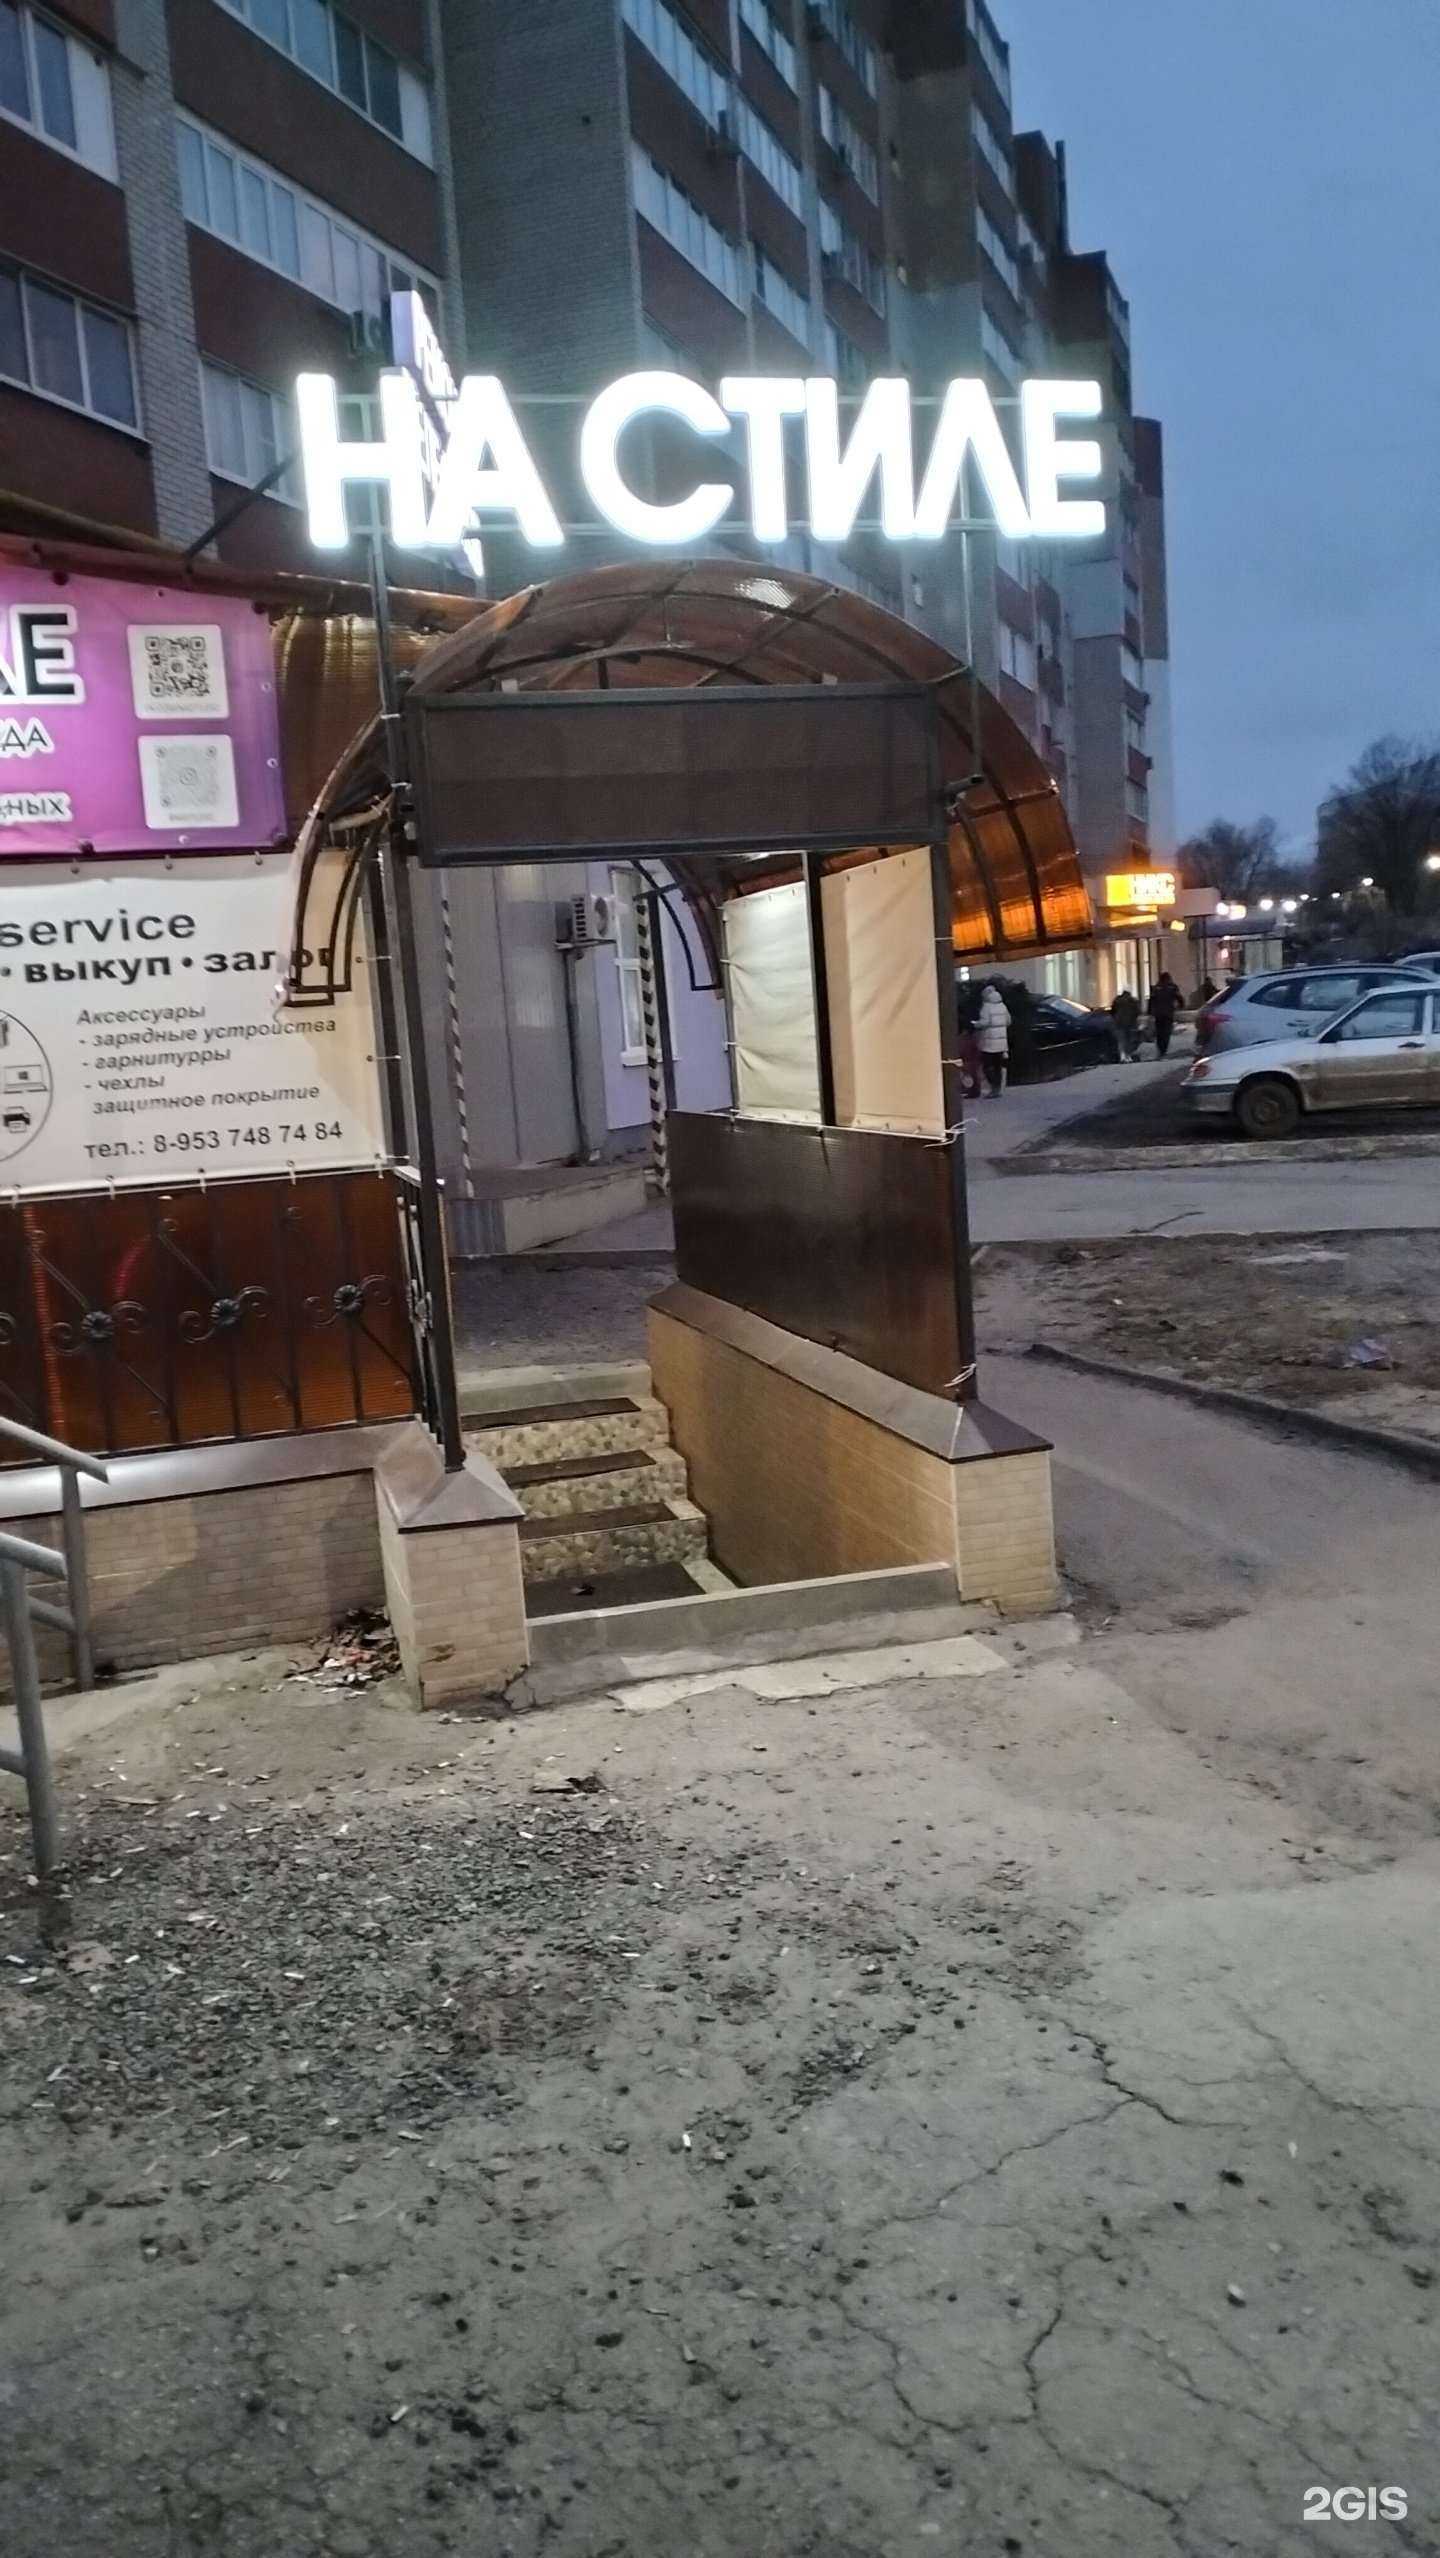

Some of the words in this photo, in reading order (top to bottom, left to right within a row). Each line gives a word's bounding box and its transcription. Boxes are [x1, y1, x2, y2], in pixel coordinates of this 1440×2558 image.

[297, 373, 563, 548] НА
[580, 371, 1106, 544] СТИЛЕ
[0, 609, 80, 699] Е
[0, 797, 65, 818] НЫХ
[0, 908, 196, 948] service
[24, 956, 172, 986] выкуп
[77, 1006, 206, 1025] Аксессуары
[93, 1027, 198, 1049] зарядные
[98, 1075, 165, 1091] чехлы
[93, 1095, 206, 1114] защитное
[211, 1085, 320, 1106] покрытие
[84, 1140, 145, 1159] тел.:
[153, 1130, 221, 1153] 8-953
[228, 1126, 272, 1147] 748
[278, 1123, 307, 1143] 74
[315, 1120, 344, 1141] 84
